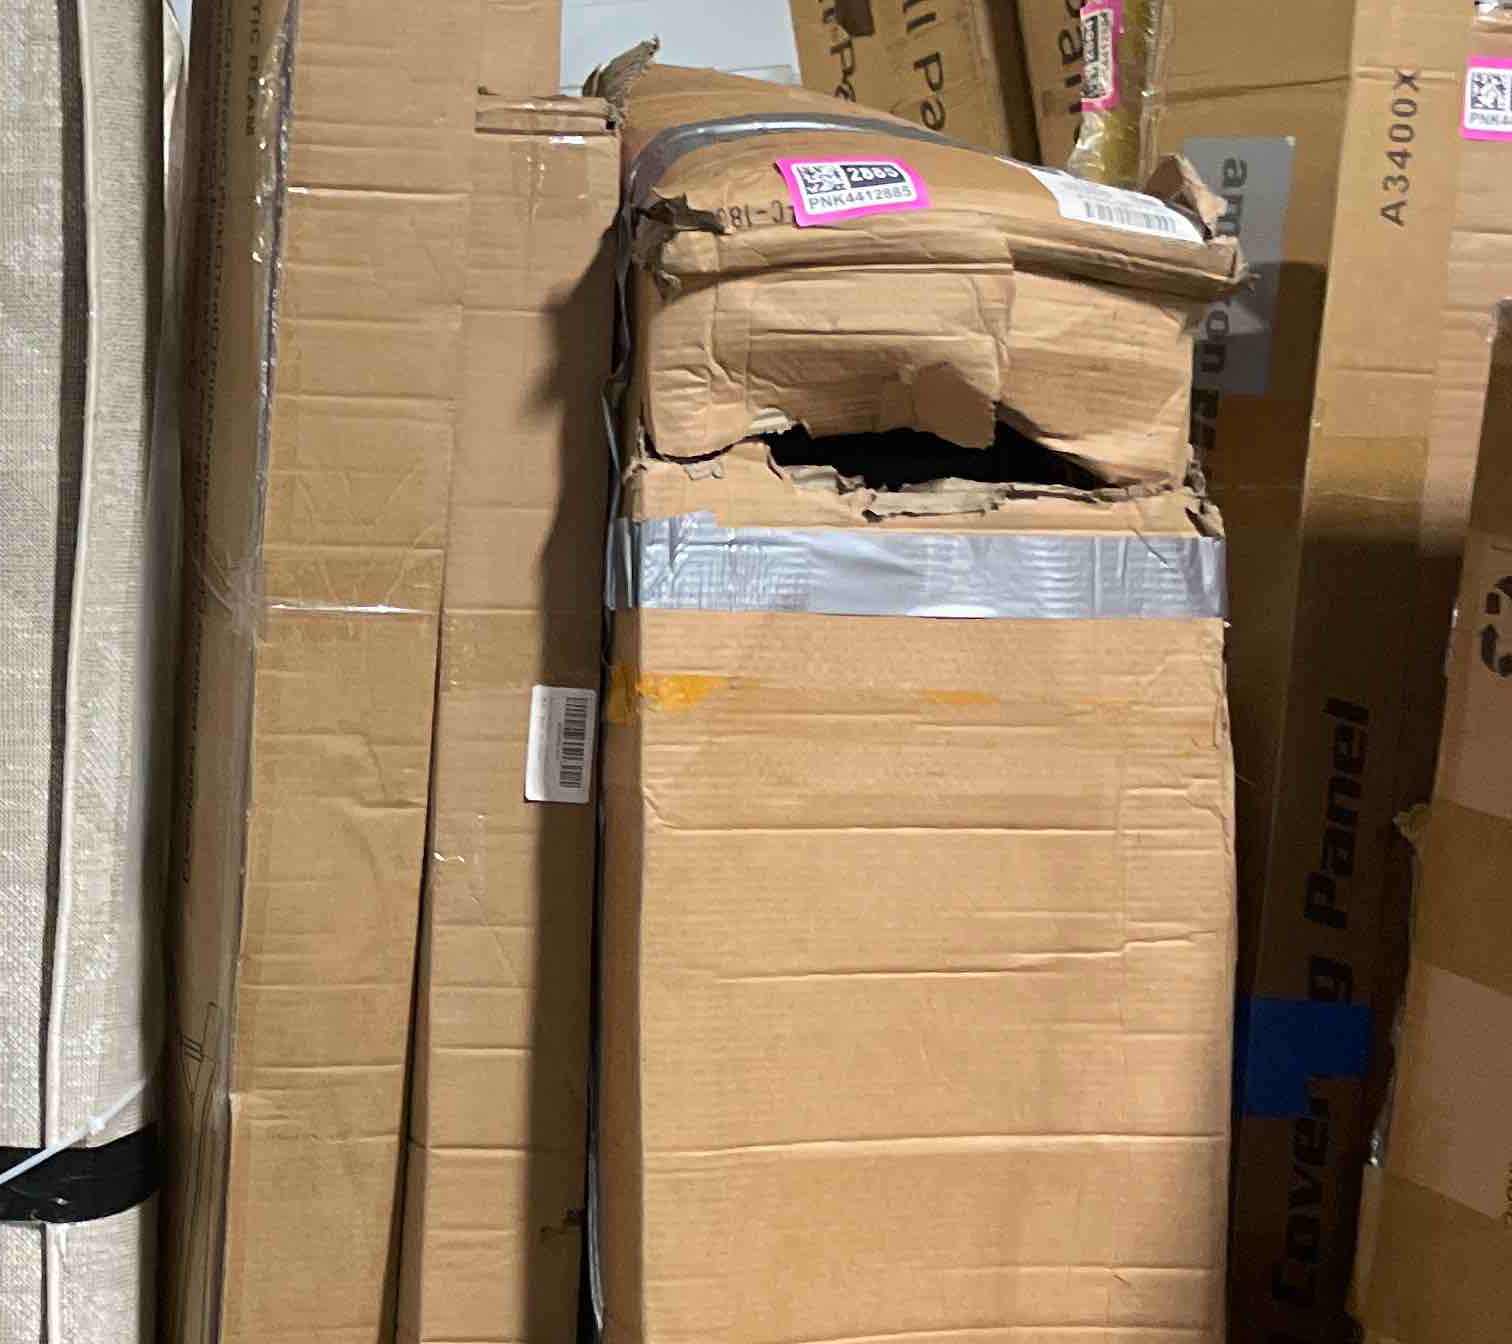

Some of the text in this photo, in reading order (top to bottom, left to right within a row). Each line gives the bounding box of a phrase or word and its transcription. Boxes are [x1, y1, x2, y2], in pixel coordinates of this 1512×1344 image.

[808, 185, 912, 210] PNK4412885
[845, 167, 900, 183] 2885
[1380, 68, 1420, 226] A3400X
[1200, 155, 1248, 374] amon
[1305, 698, 1371, 929] Panel
[1270, 955, 1354, 1307] Coverg
